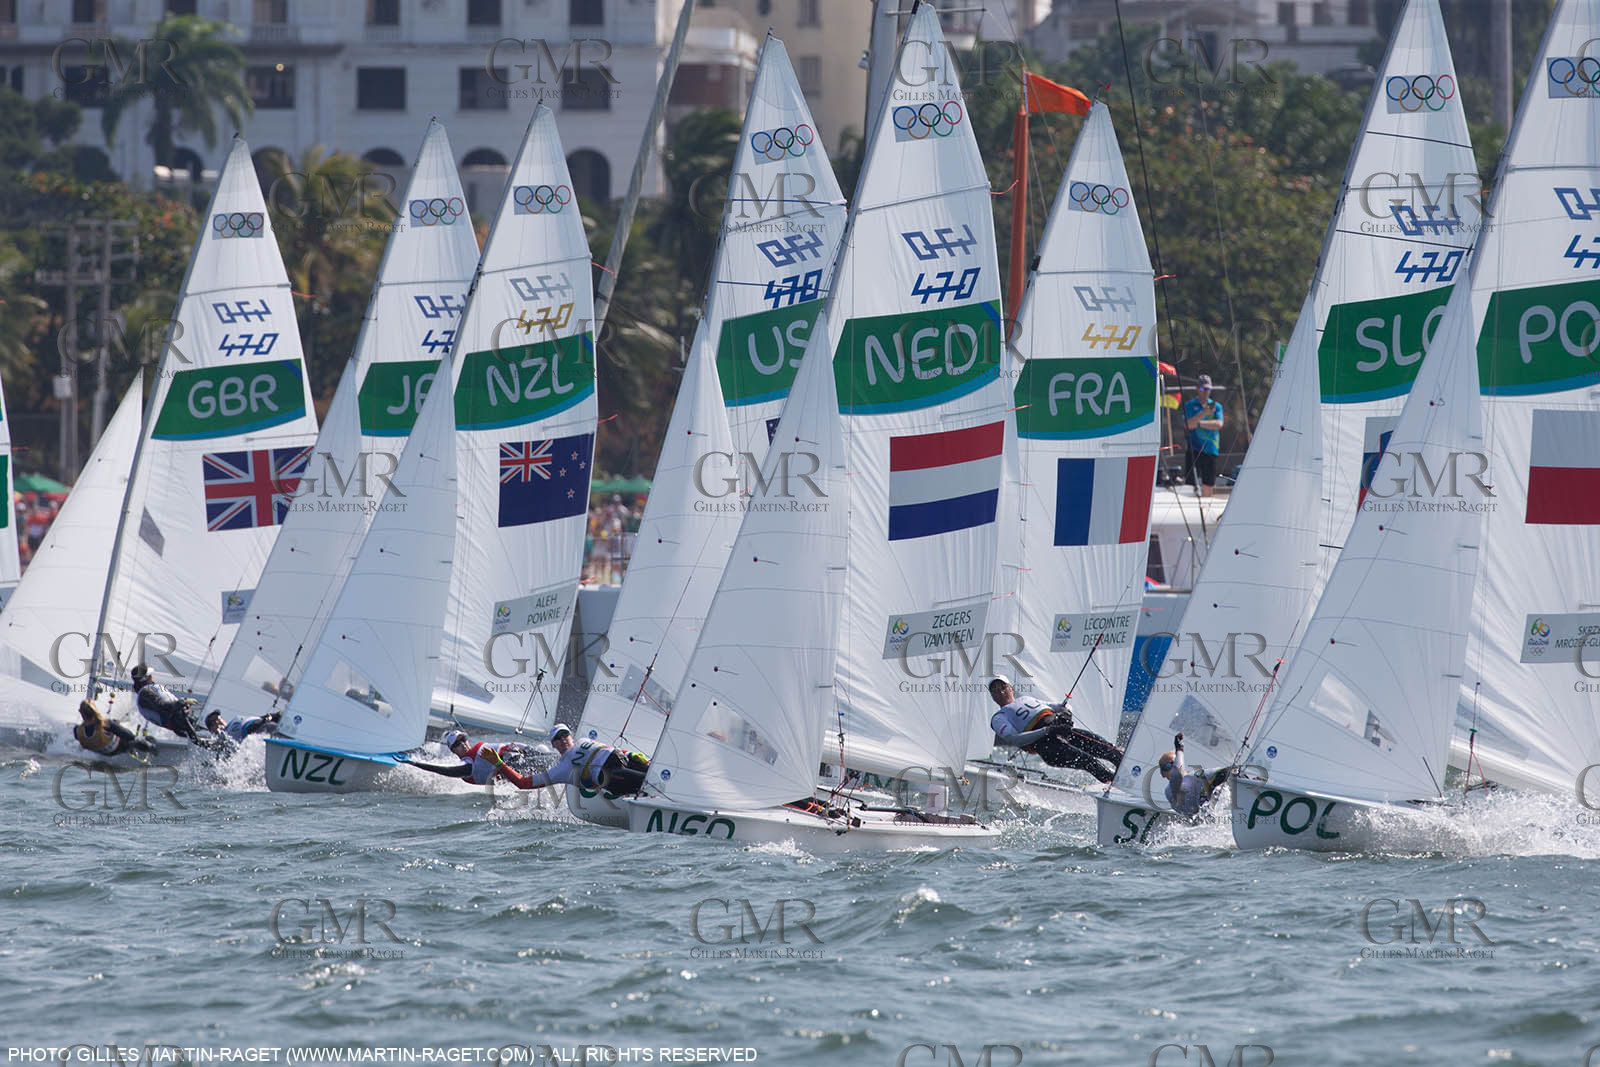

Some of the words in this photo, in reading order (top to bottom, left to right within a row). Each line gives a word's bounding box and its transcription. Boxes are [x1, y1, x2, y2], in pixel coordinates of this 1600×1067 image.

[1394, 250, 1464, 283] 470
[763, 268, 823, 309] 470
[911, 267, 981, 304] 470
[516, 303, 574, 334] 470
[218, 333, 279, 357] 470
[1081, 323, 1142, 350] 470
[865, 324, 978, 386] NED
[188, 374, 279, 419] GBR
[486, 354, 574, 406] NZL
[1048, 371, 1131, 417] FRA
[526, 606, 561, 626] POWRIE
[535, 593, 558, 609] ALEH
[932, 609, 972, 629] ZEGERS
[1083, 615, 1131, 631] LECOINTRE
[1081, 631, 1127, 647] DEFRANCE
[280, 748, 347, 785] NZL
[1247, 790, 1340, 839] POL
